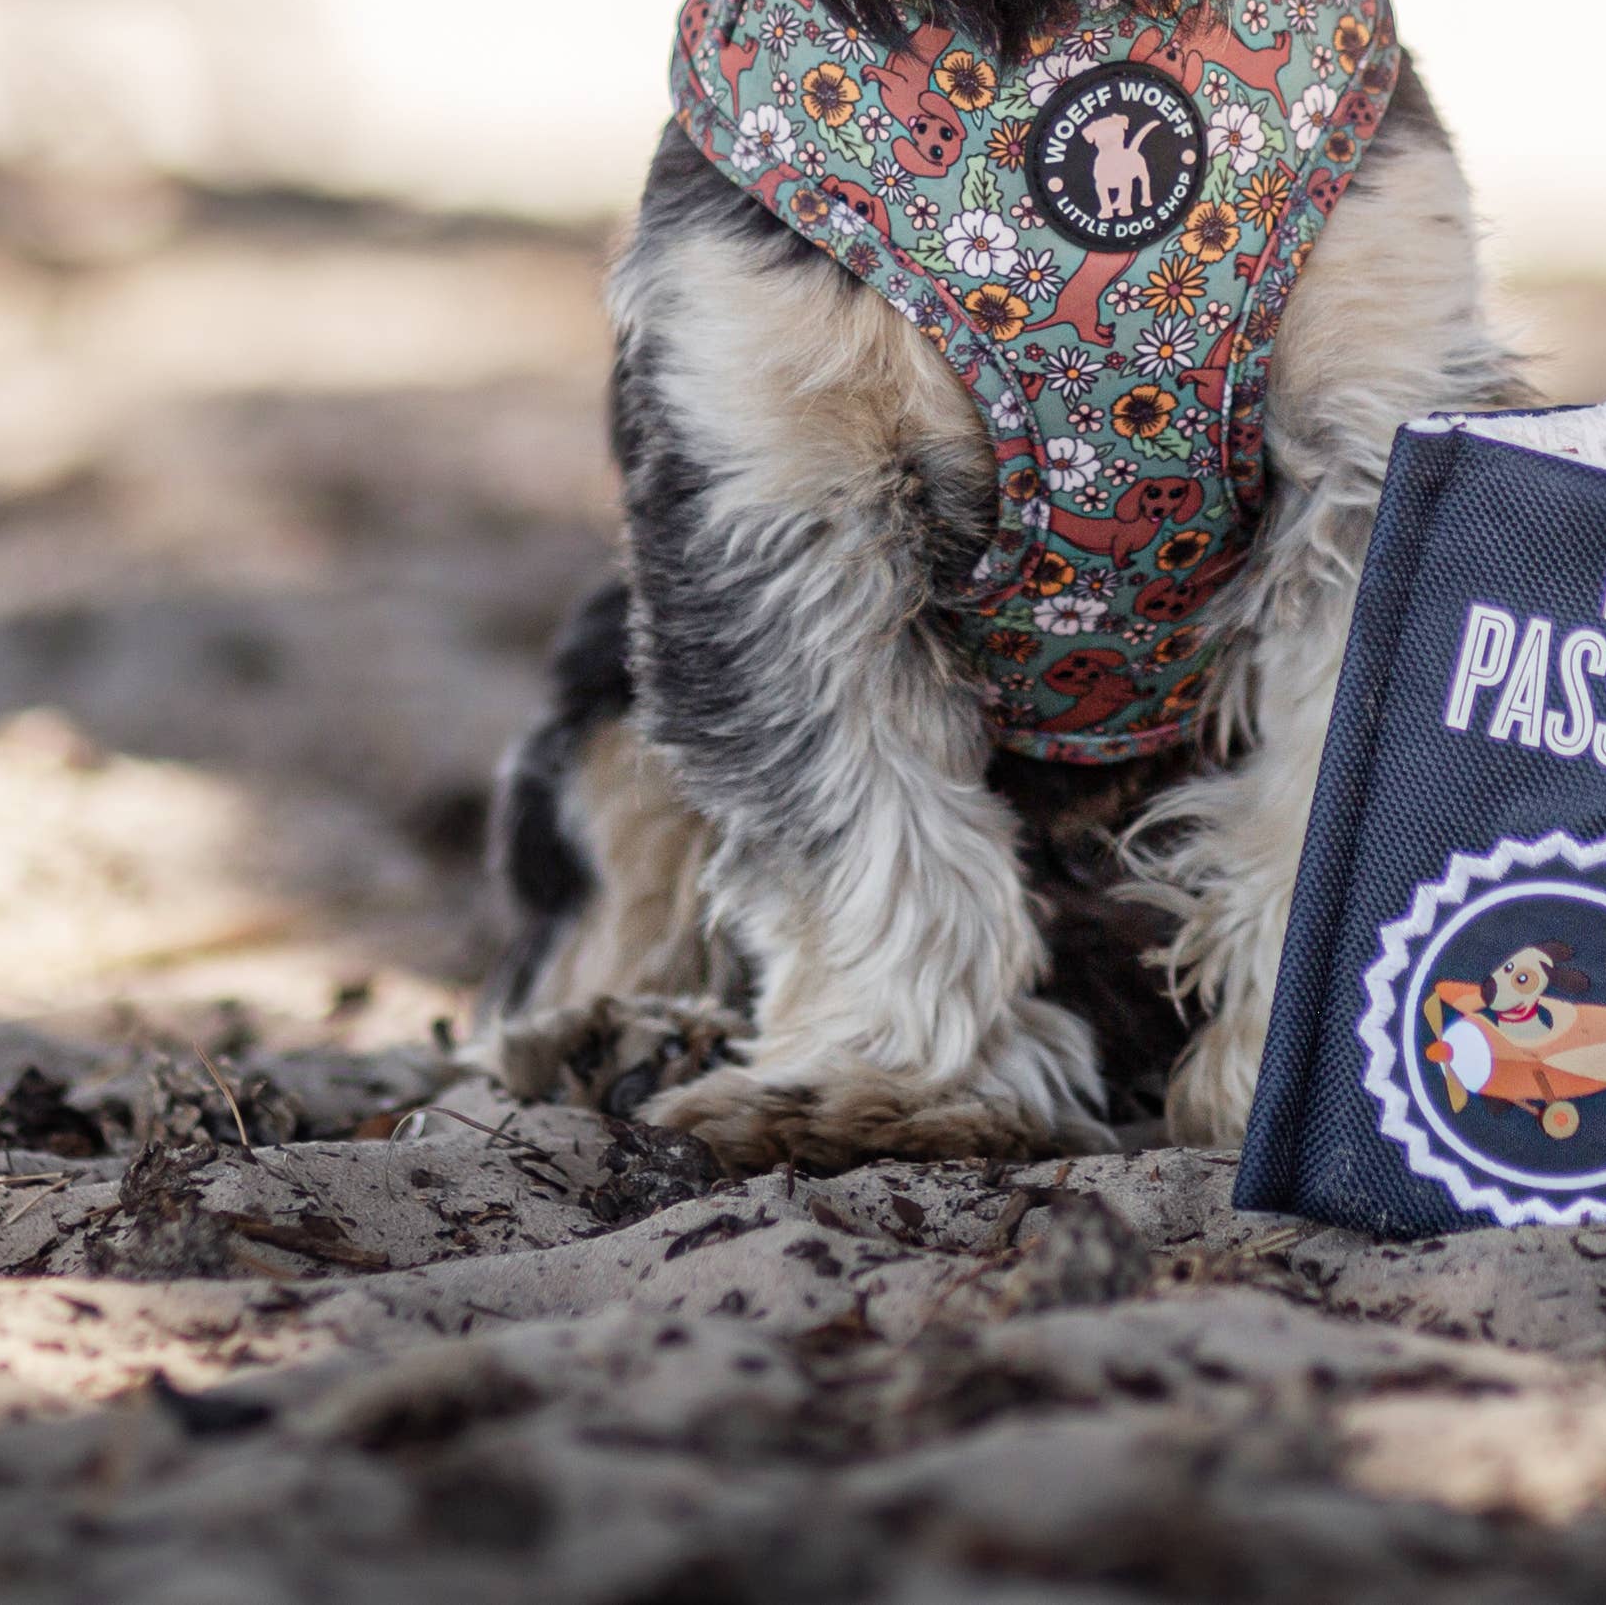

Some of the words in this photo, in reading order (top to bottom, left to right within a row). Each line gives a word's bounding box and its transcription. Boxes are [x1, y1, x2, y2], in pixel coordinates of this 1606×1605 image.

[1045, 85, 1113, 164] WOEFF
[1118, 82, 1194, 138] WOEFF
[1056, 196, 1110, 237] LITTLE
[1114, 216, 1155, 238] DOG
[1156, 172, 1191, 221] SHOP
